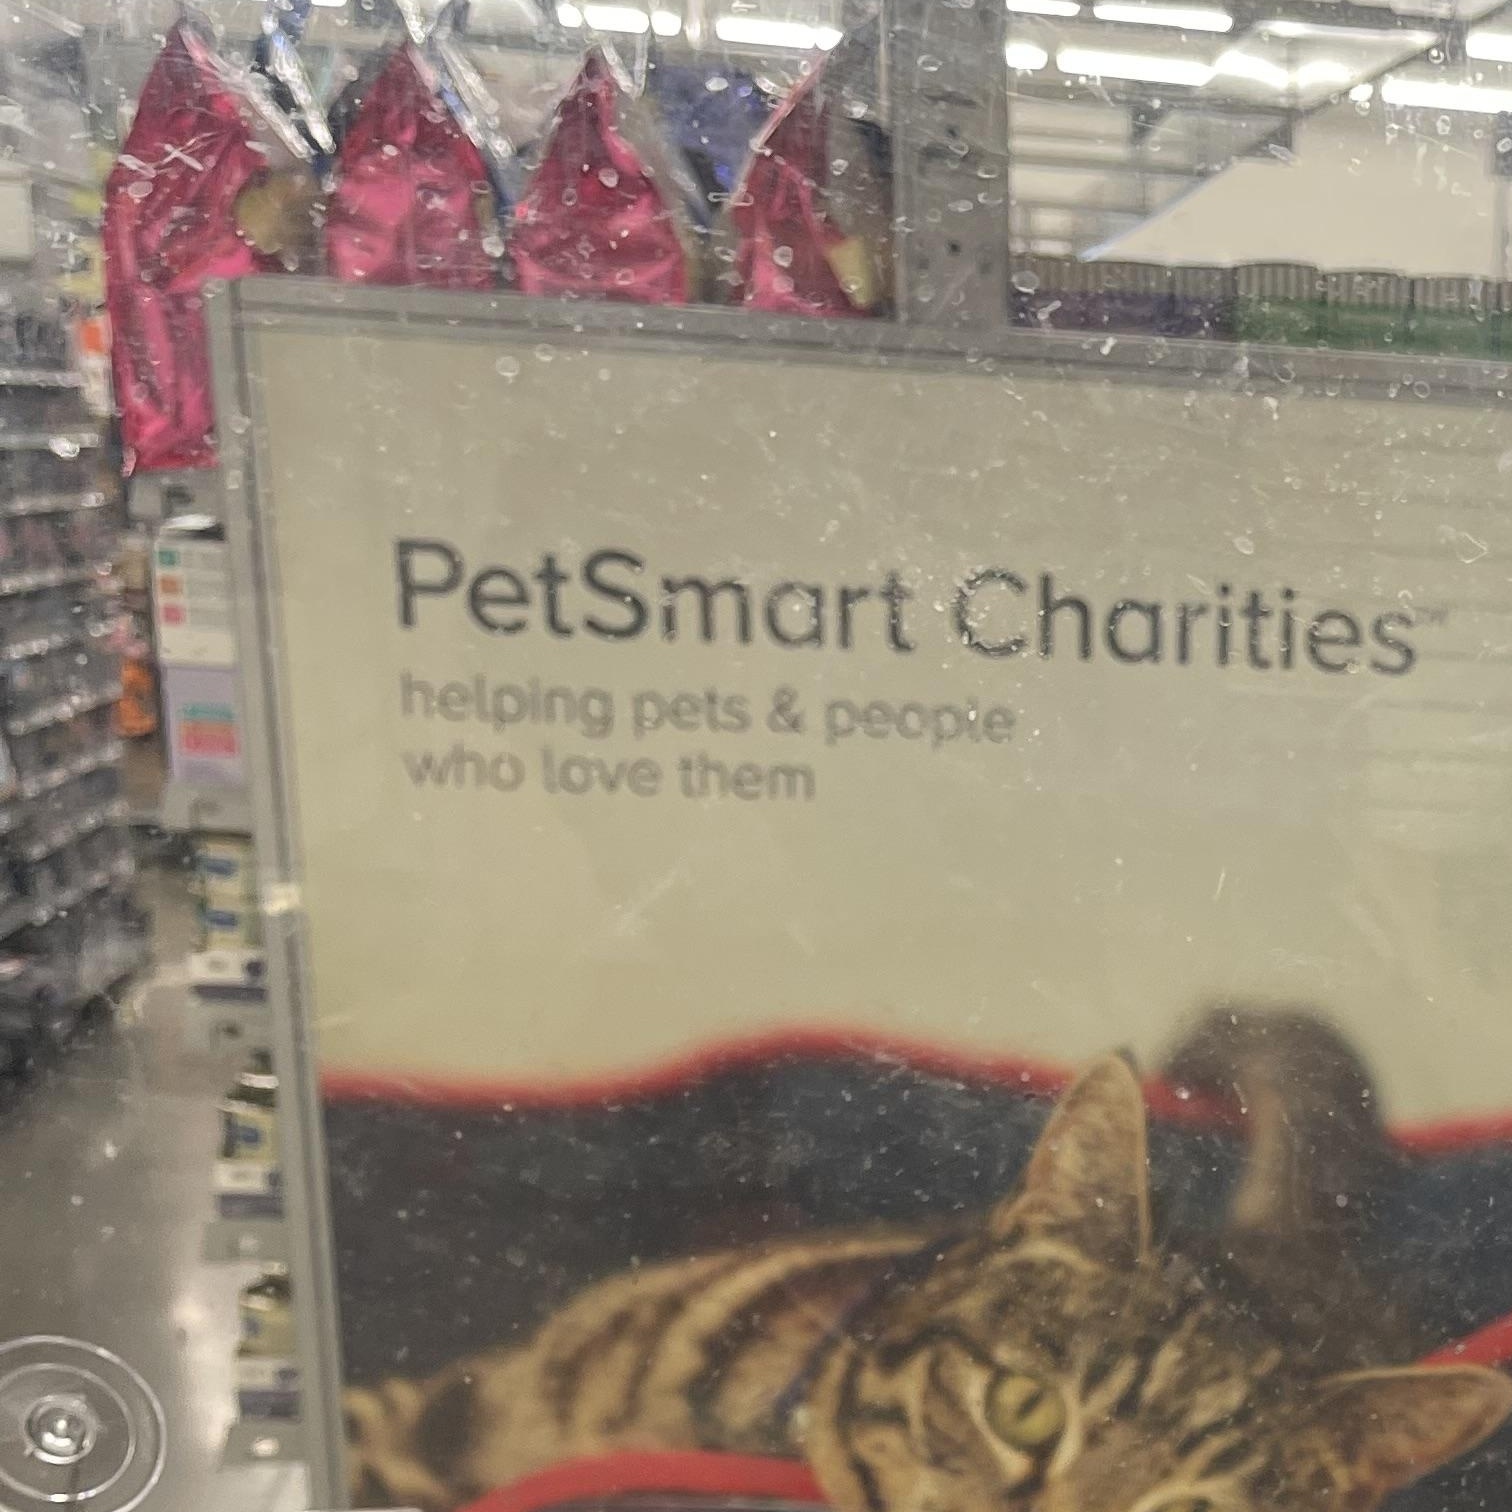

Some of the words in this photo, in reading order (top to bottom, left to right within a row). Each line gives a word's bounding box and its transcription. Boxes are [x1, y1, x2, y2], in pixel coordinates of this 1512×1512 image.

[395, 537, 916, 652] PetSmart
[955, 566, 1417, 676] Charities
[399, 670, 616, 739] helping
[630, 686, 753, 740] pets
[765, 684, 807, 735] &
[824, 697, 1016, 751] people
[401, 743, 527, 792] who
[540, 746, 665, 797] love
[677, 751, 818, 801] them
